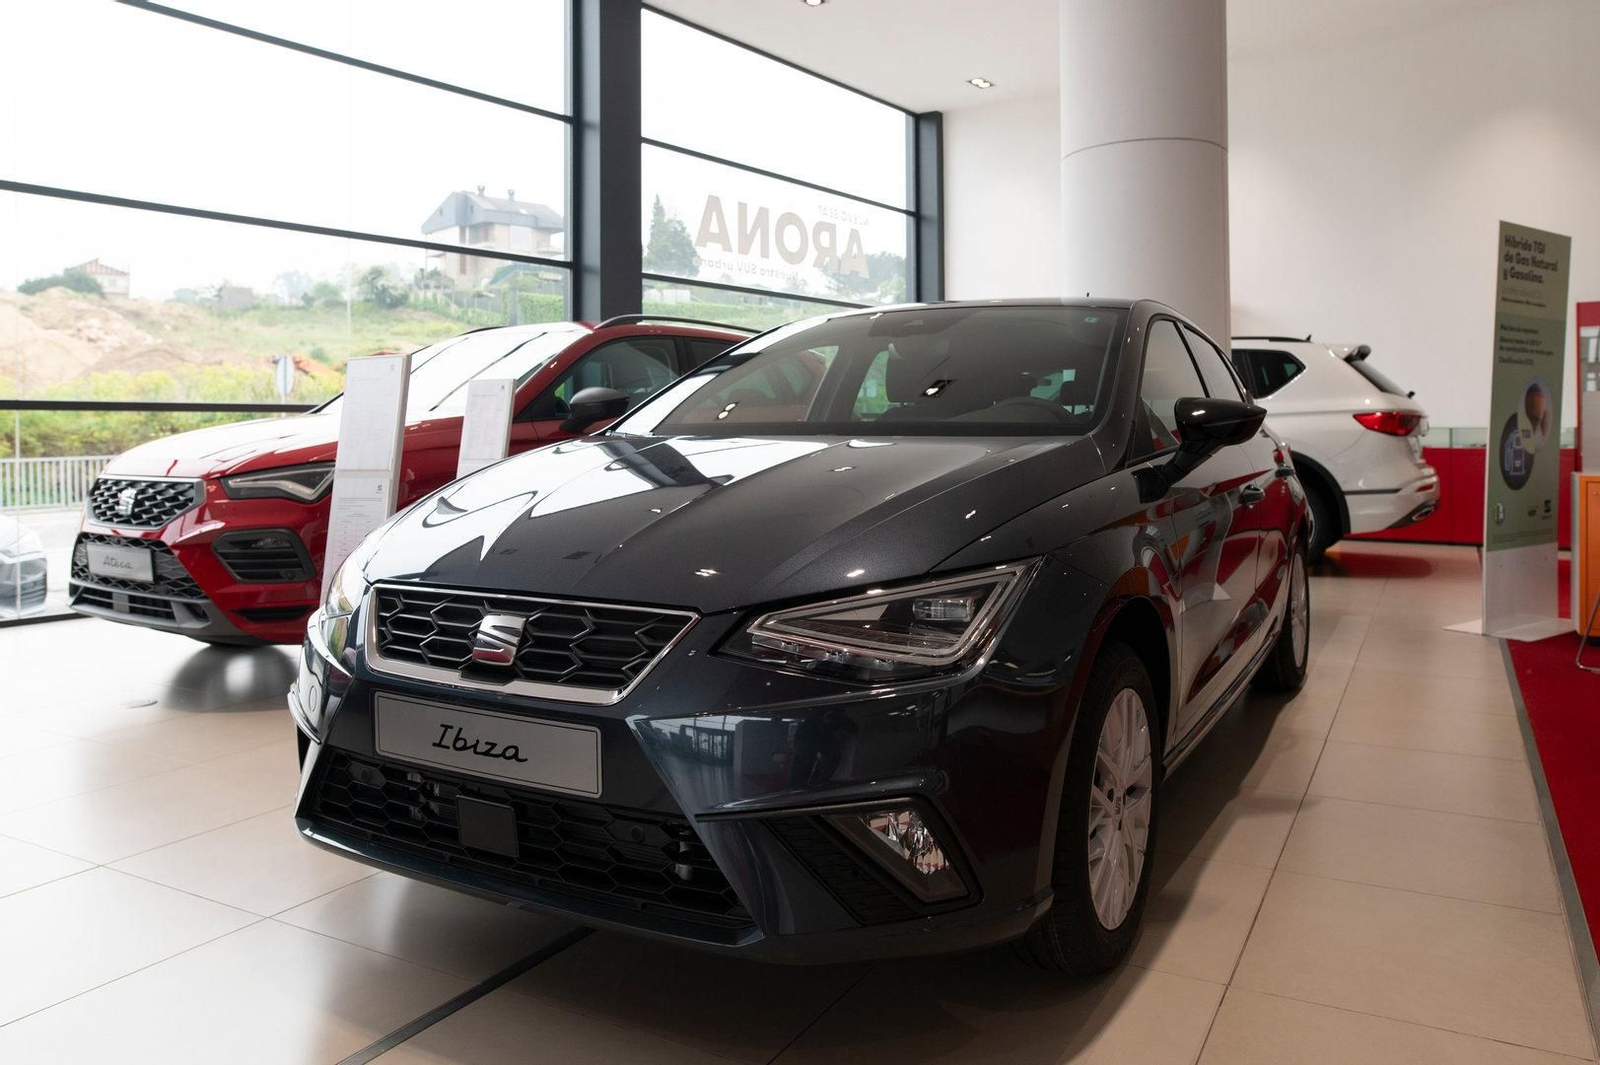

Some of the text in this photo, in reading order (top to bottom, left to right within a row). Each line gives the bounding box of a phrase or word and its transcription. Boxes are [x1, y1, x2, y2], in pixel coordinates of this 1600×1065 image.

[1503, 251, 1558, 272] de Gas Natural
[102, 554, 133, 570] Ateca
[432, 723, 528, 763] Ibiza
